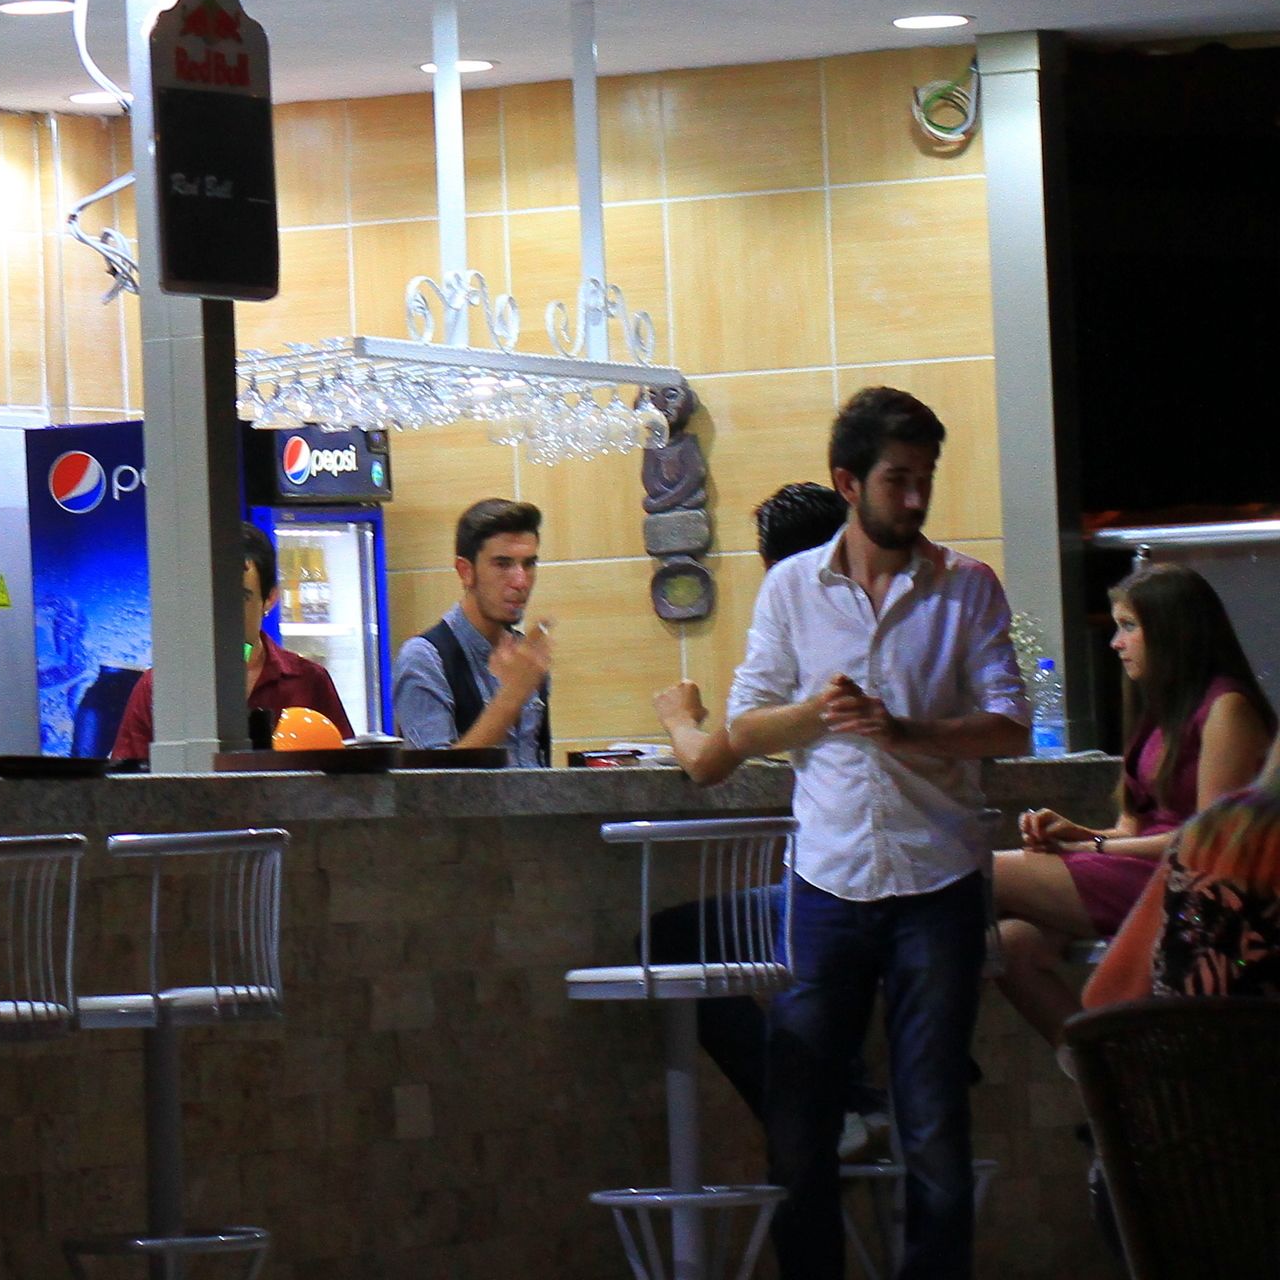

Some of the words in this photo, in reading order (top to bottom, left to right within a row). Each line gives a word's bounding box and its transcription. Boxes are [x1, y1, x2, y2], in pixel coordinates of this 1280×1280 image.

[174, 46, 210, 82] Red
[213, 52, 252, 87] Bull
[310, 444, 358, 477] pepsi
